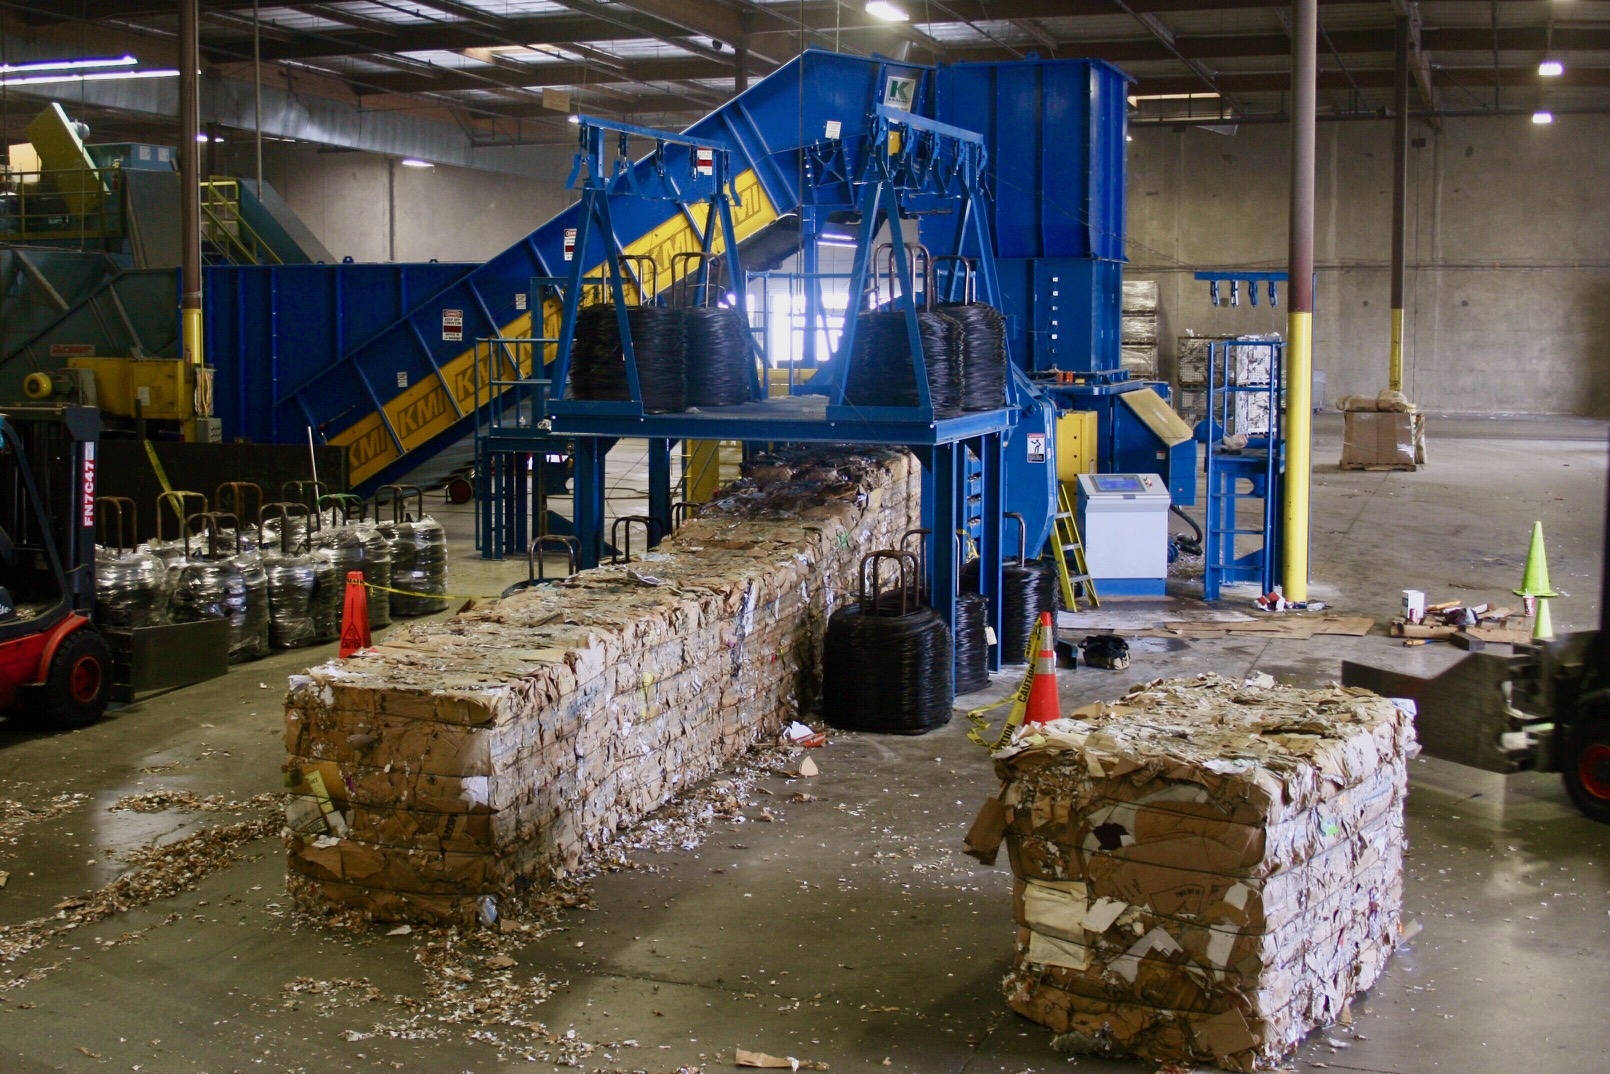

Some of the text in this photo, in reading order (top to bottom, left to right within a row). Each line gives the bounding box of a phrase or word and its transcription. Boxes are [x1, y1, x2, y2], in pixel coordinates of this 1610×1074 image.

[890, 80, 910, 99] K
[398, 386, 447, 440] KMI
[84, 461, 94, 527] FN7C47
[1018, 663, 1036, 703] CAUTION
